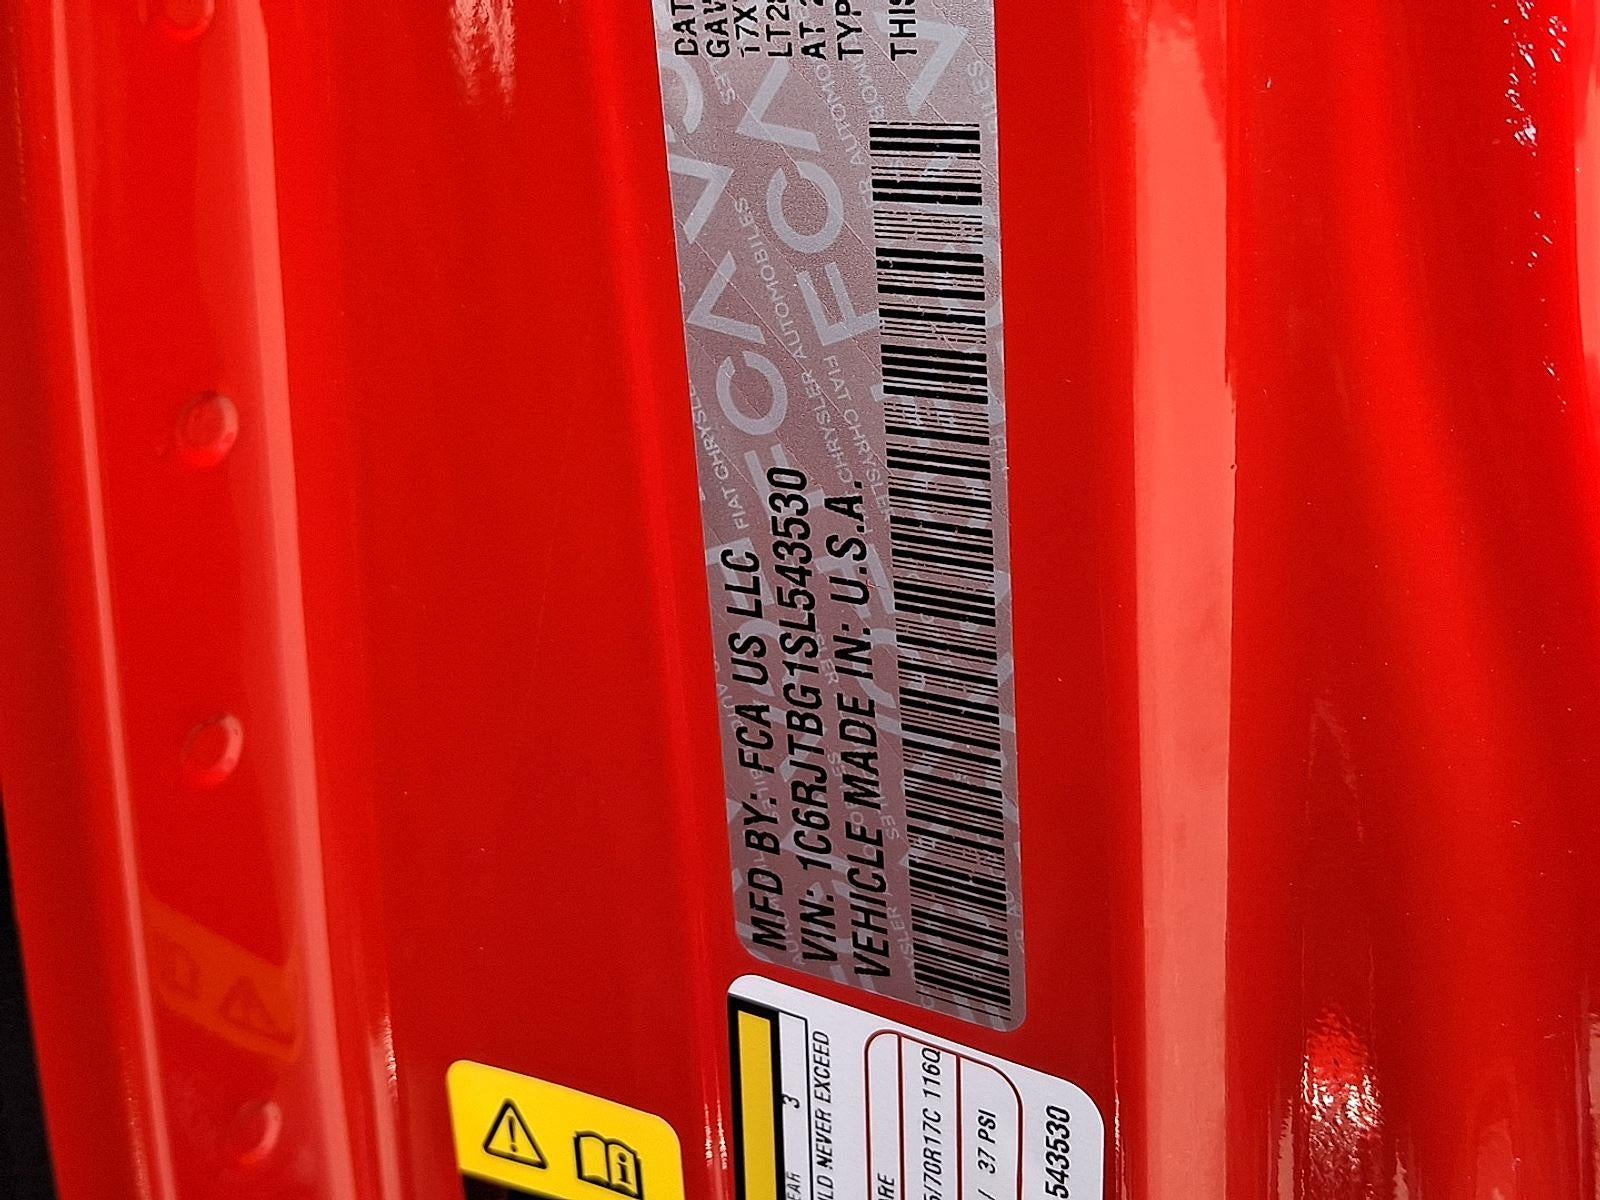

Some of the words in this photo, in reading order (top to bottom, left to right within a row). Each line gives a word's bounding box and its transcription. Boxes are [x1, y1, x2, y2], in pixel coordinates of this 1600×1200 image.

[732, 0, 761, 58] 17X
[766, 0, 793, 57] LT2
[799, 21, 827, 61] AT
[835, 0, 864, 61] TYP
[733, 196, 808, 359] AUTOMOBILES
[722, 485, 751, 530] FIAT
[823, 479, 870, 606] U.S.A.
[720, 549, 764, 619] LLC
[728, 632, 769, 686] US
[766, 466, 833, 871] 1C6RJTBG1SL543530
[832, 623, 874, 680] IN:
[734, 704, 776, 774] FCA
[836, 692, 882, 810] MADE
[741, 792, 781, 856] BY:
[746, 867, 787, 951] MFD
[798, 889, 838, 962] VIN:
[844, 821, 891, 978] VEHICLE
[812, 1030, 832, 1103] EXCEED
[921, 1047, 941, 1099] 116Q
[781, 1093, 800, 1109] 3
[977, 1108, 996, 1144] PSI
[814, 1108, 833, 1169] NEVER
[977, 1146, 996, 1174] 37
[1045, 1105, 1071, 1199] 543530
